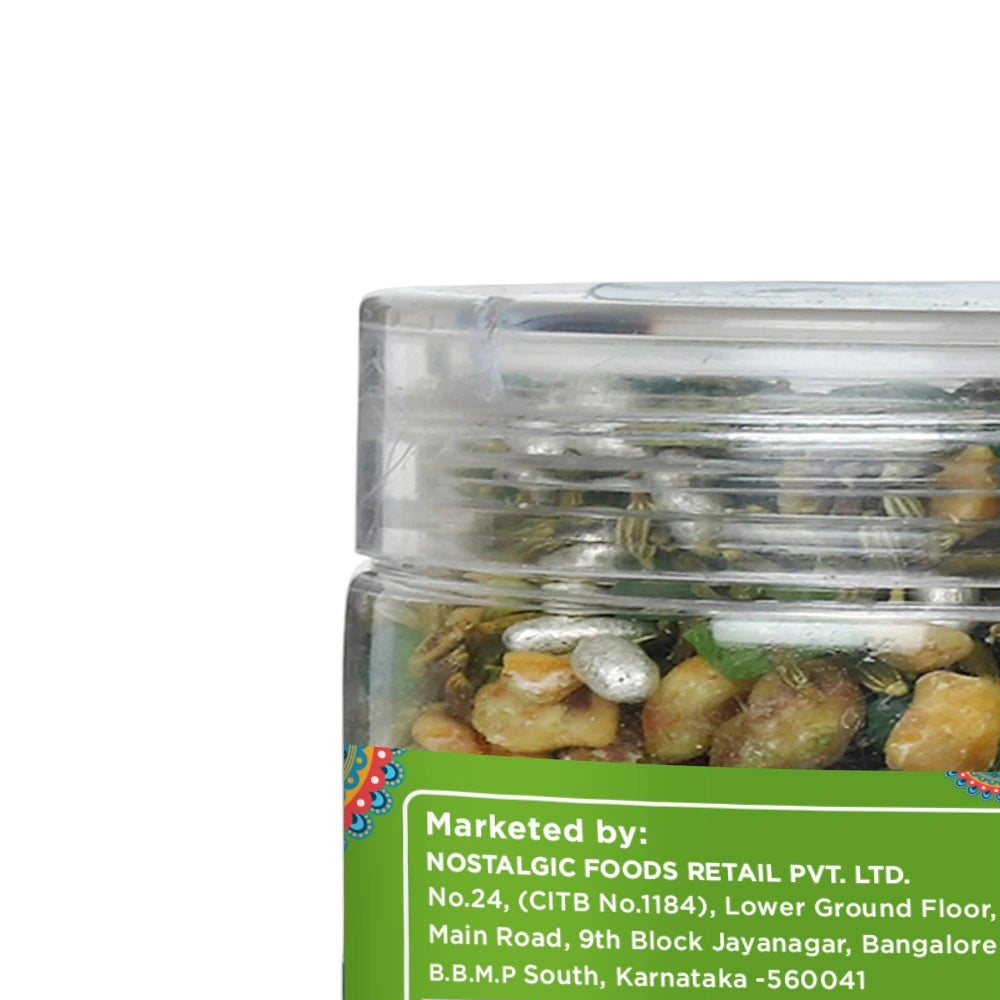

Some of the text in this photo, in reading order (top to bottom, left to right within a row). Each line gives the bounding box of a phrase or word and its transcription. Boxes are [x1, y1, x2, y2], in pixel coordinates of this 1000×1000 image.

[427, 811, 647, 849] Marketed by:
[427, 852, 910, 884] NOSTALGIC FOODS RETAIL PVT. LTD.
[429, 887, 509, 912] No.24,
[519, 890, 590, 912] (CITB
[600, 893, 715, 918] No.1184),
[726, 896, 805, 916] Lower
[815, 898, 911, 918] Ground
[922, 899, 995, 921] Floor,
[429, 924, 487, 945] Main
[497, 927, 570, 951] Road,
[579, 929, 620, 949] 9th
[631, 930, 702, 951] Block
[713, 933, 851, 957] Jayanagar,
[863, 935, 996, 958] Bangalore
[430, 963, 864, 990] B.B.M.P South, Karnataka -560041
